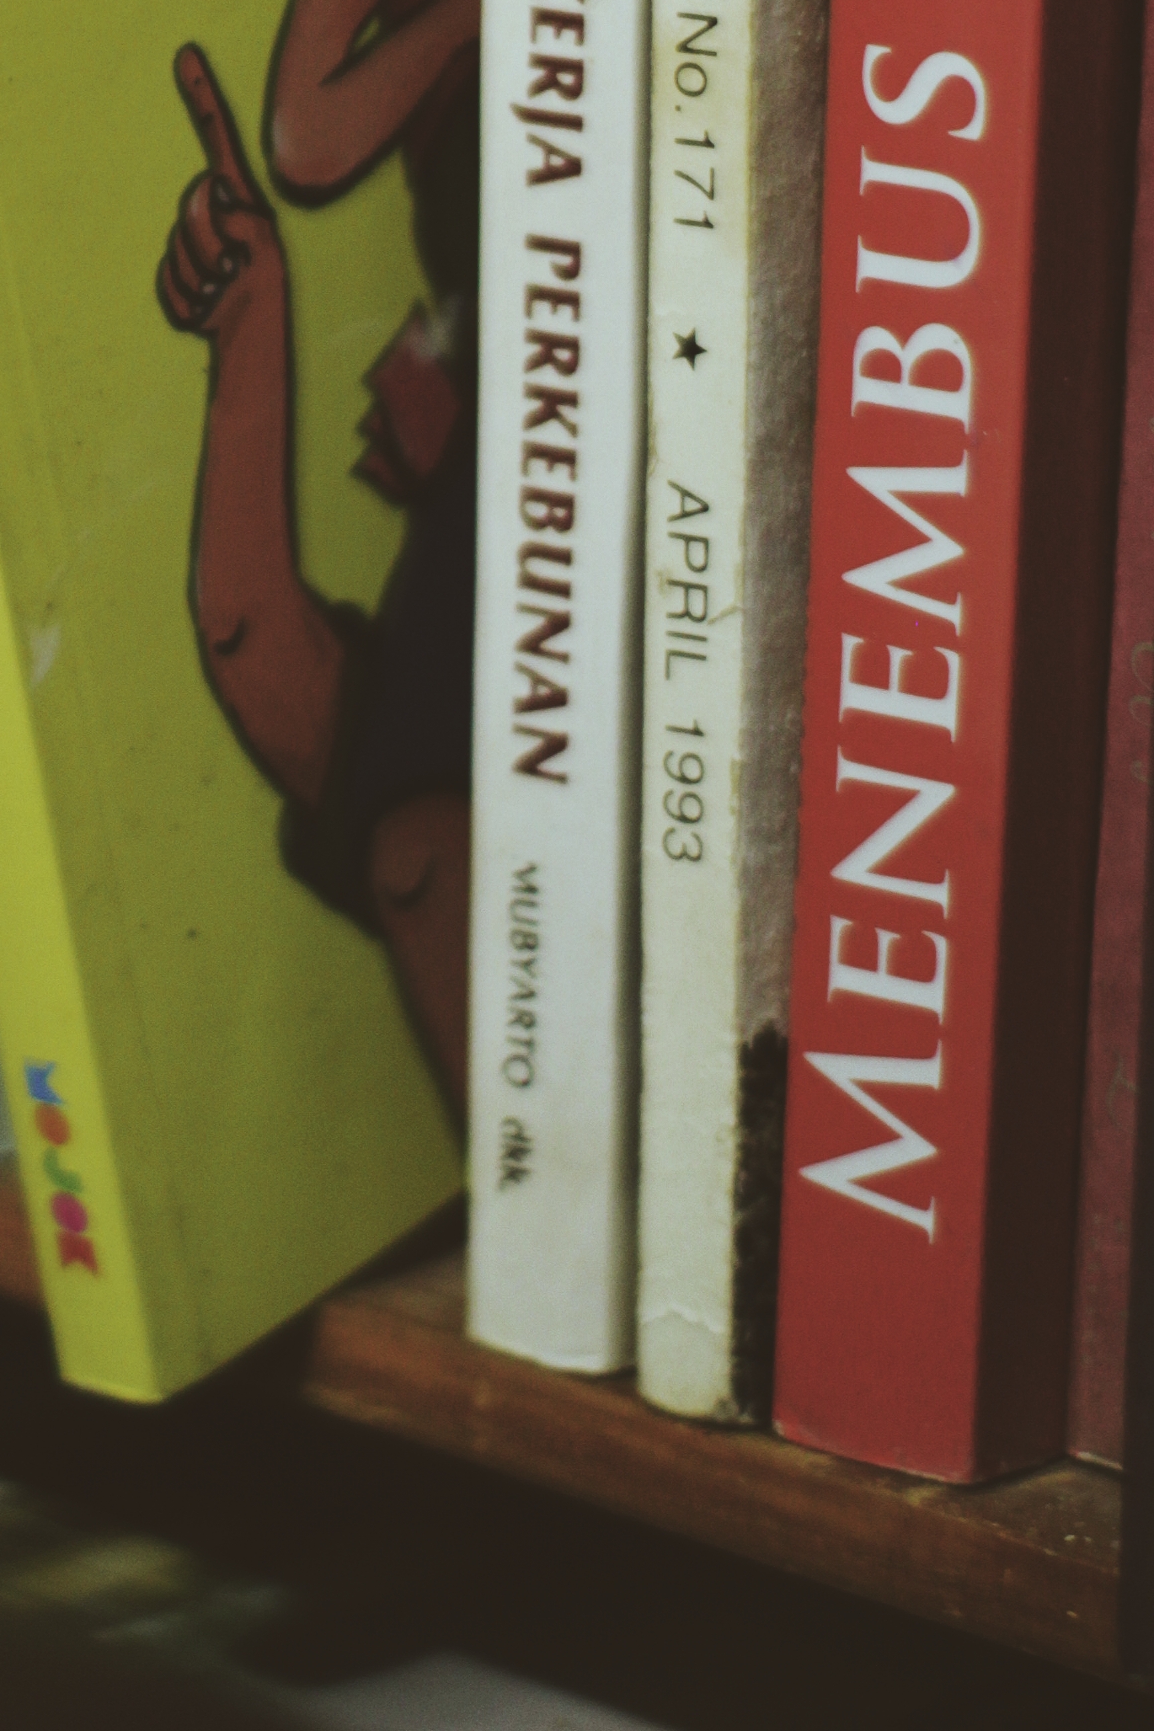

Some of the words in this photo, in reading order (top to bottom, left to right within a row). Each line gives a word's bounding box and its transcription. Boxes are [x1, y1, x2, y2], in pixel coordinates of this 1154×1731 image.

[511, 233, 582, 786] PERKEBUNAN
[664, 478, 710, 682] APRIL
[797, 43, 989, 1244] MENEMBUS
[662, 717, 706, 865] 1993
[501, 861, 543, 1089] MUBYARTO
[498, 1116, 533, 1191] dkk
